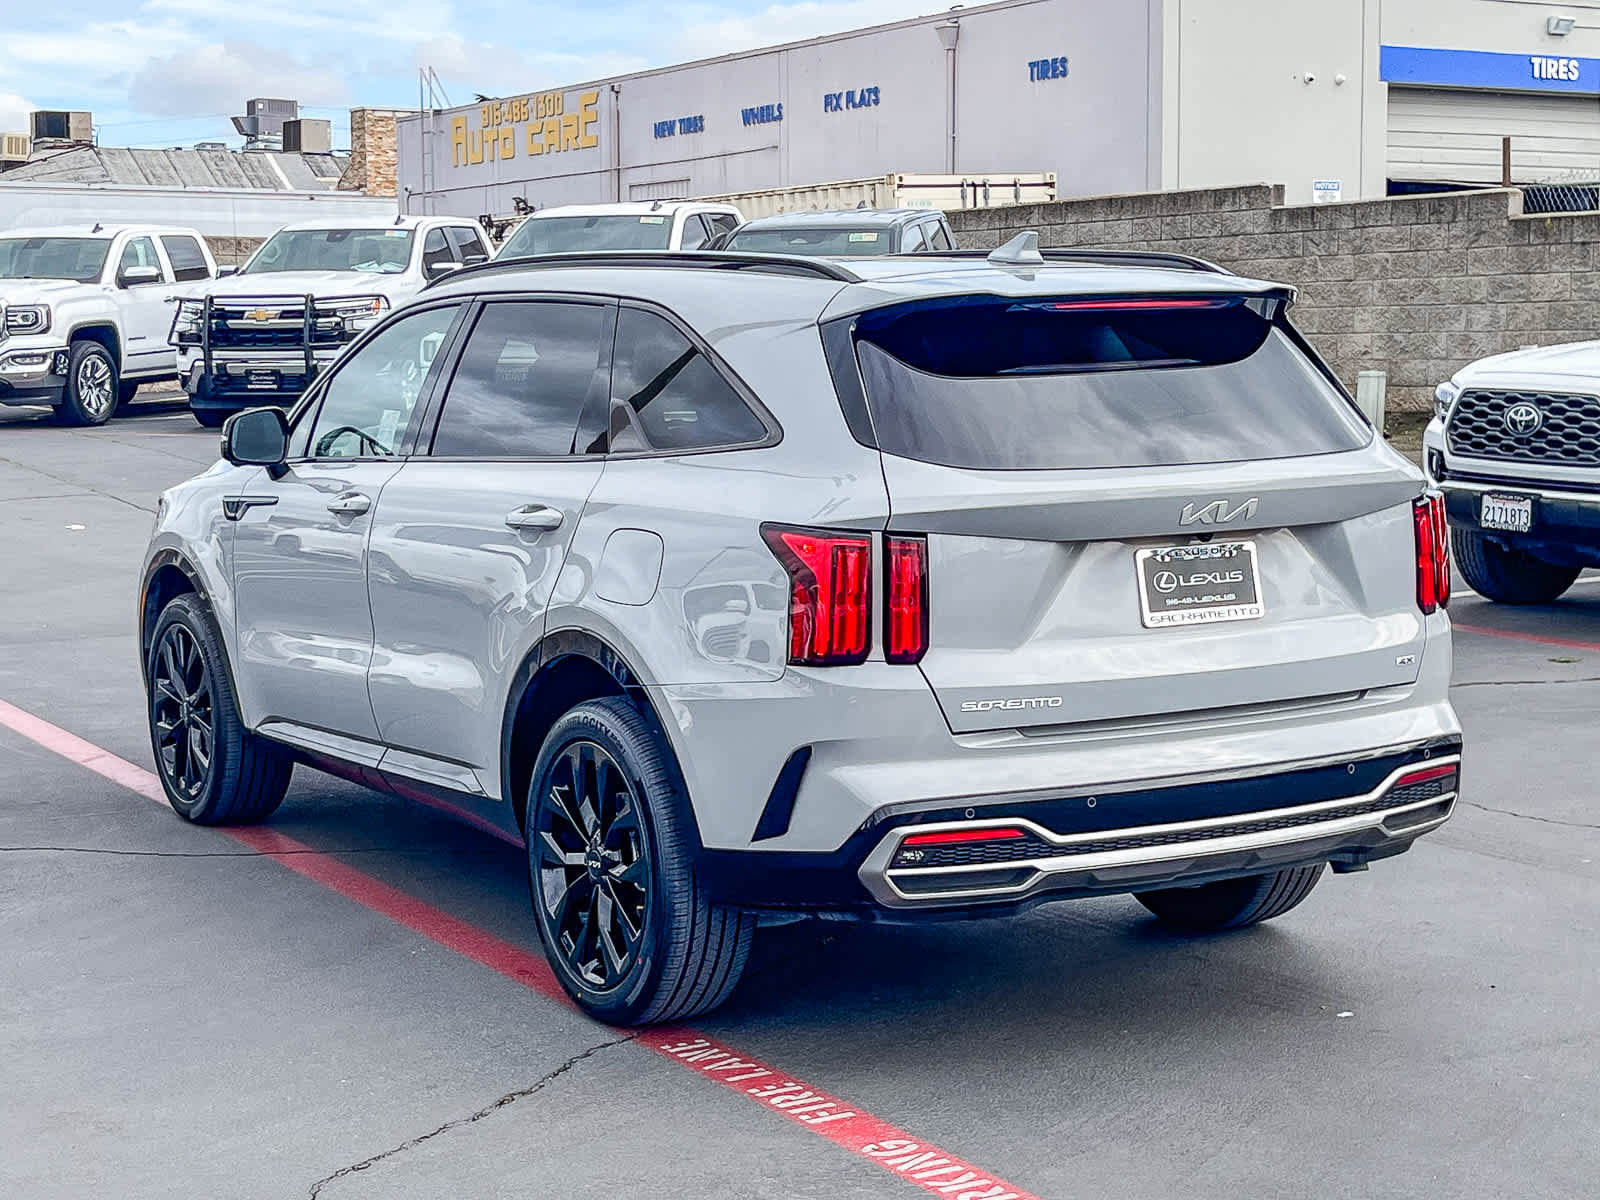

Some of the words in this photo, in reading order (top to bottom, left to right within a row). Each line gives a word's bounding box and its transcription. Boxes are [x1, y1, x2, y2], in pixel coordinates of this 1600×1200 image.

[1028, 57, 1068, 82] TIRES
[1531, 57, 1579, 80] TIRES
[824, 92, 843, 112] FIX
[845, 86, 880, 110] FLATS
[654, 120, 675, 140] NEW
[678, 114, 704, 135] TIRES
[741, 102, 783, 127] WHEELS
[1179, 498, 1259, 526] KIA
[1179, 570, 1244, 586] LEXUS
[1150, 608, 1260, 624] SACRAMENTO
[961, 696, 1063, 712] SORENTO
[660, 1039, 773, 1082] LANE
[749, 1081, 856, 1124] FIRE
